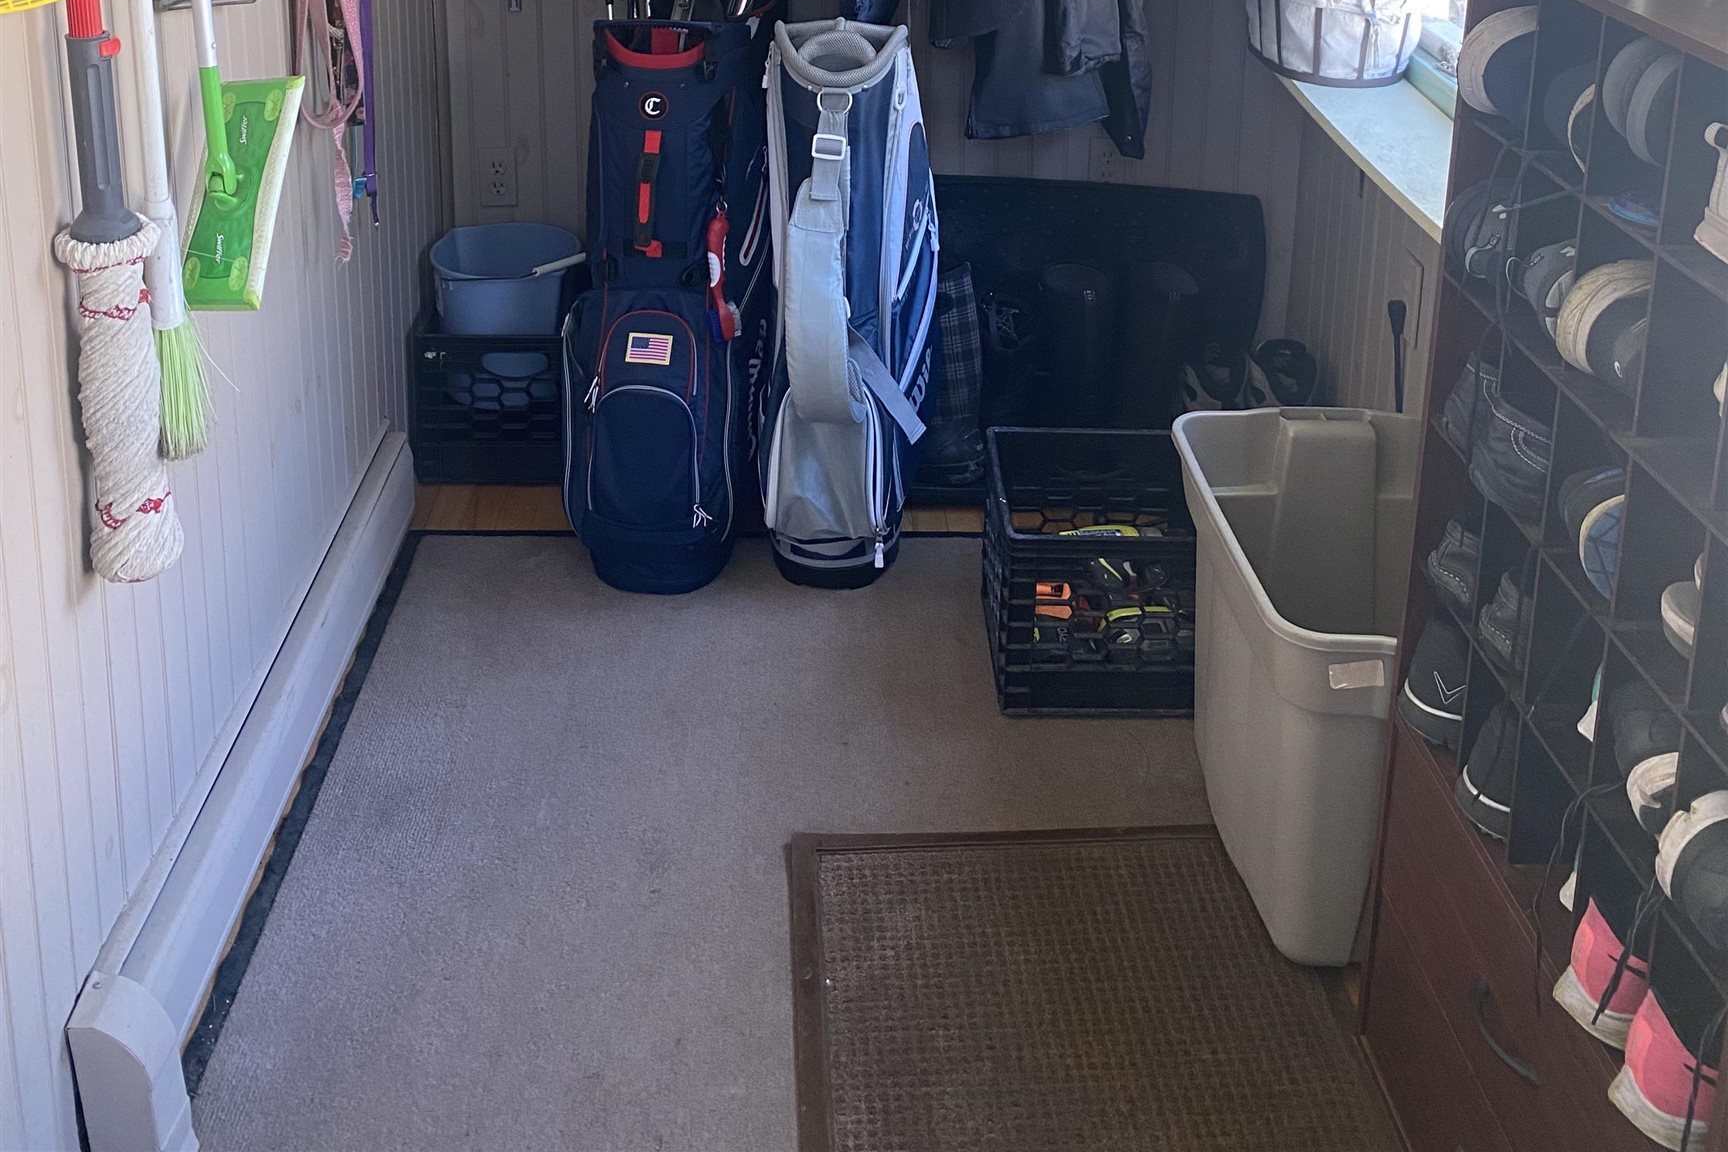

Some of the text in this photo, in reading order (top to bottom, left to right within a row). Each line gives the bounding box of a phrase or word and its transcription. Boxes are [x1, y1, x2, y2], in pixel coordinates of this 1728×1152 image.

[645, 97, 661, 115] C
[239, 115, 249, 145] Swiffer
[215, 233, 225, 264] Swiffer
